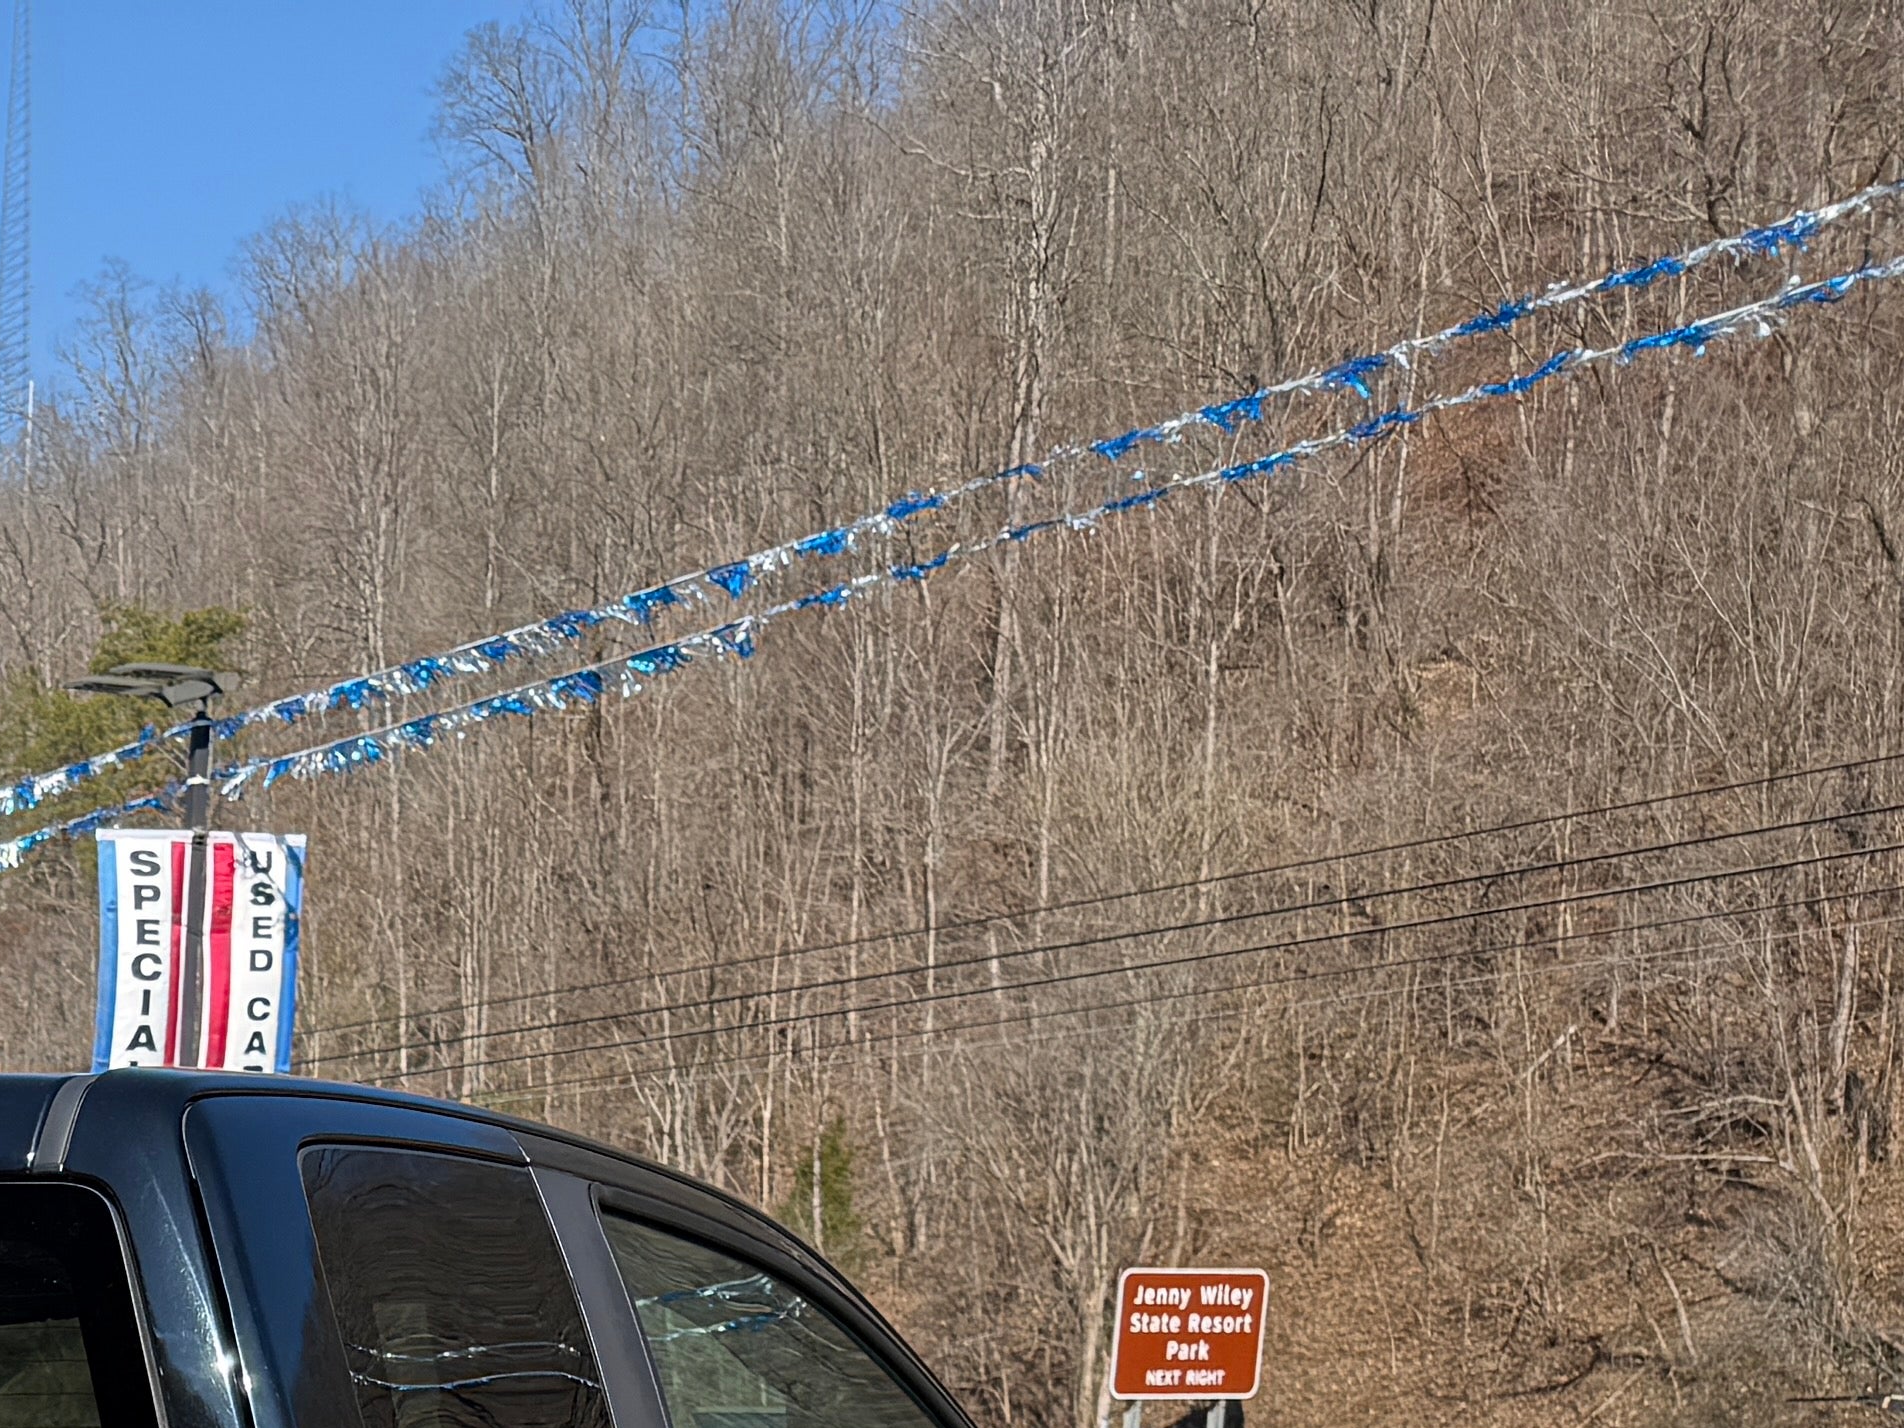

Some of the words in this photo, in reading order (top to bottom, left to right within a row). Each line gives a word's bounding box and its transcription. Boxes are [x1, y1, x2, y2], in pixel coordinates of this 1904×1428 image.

[248, 850, 274, 973] USED
[126, 849, 163, 1068] SPECIA
[244, 997, 271, 1072] CA
[1133, 1284, 1191, 1311] Jenny
[1200, 1283, 1254, 1311] Wiley
[1129, 1312, 1182, 1334] State
[1188, 1313, 1253, 1334] Resort
[1165, 1339, 1210, 1361] Park
[1145, 1369, 1182, 1386] NEXT
[1185, 1369, 1226, 1386] RIGHT
